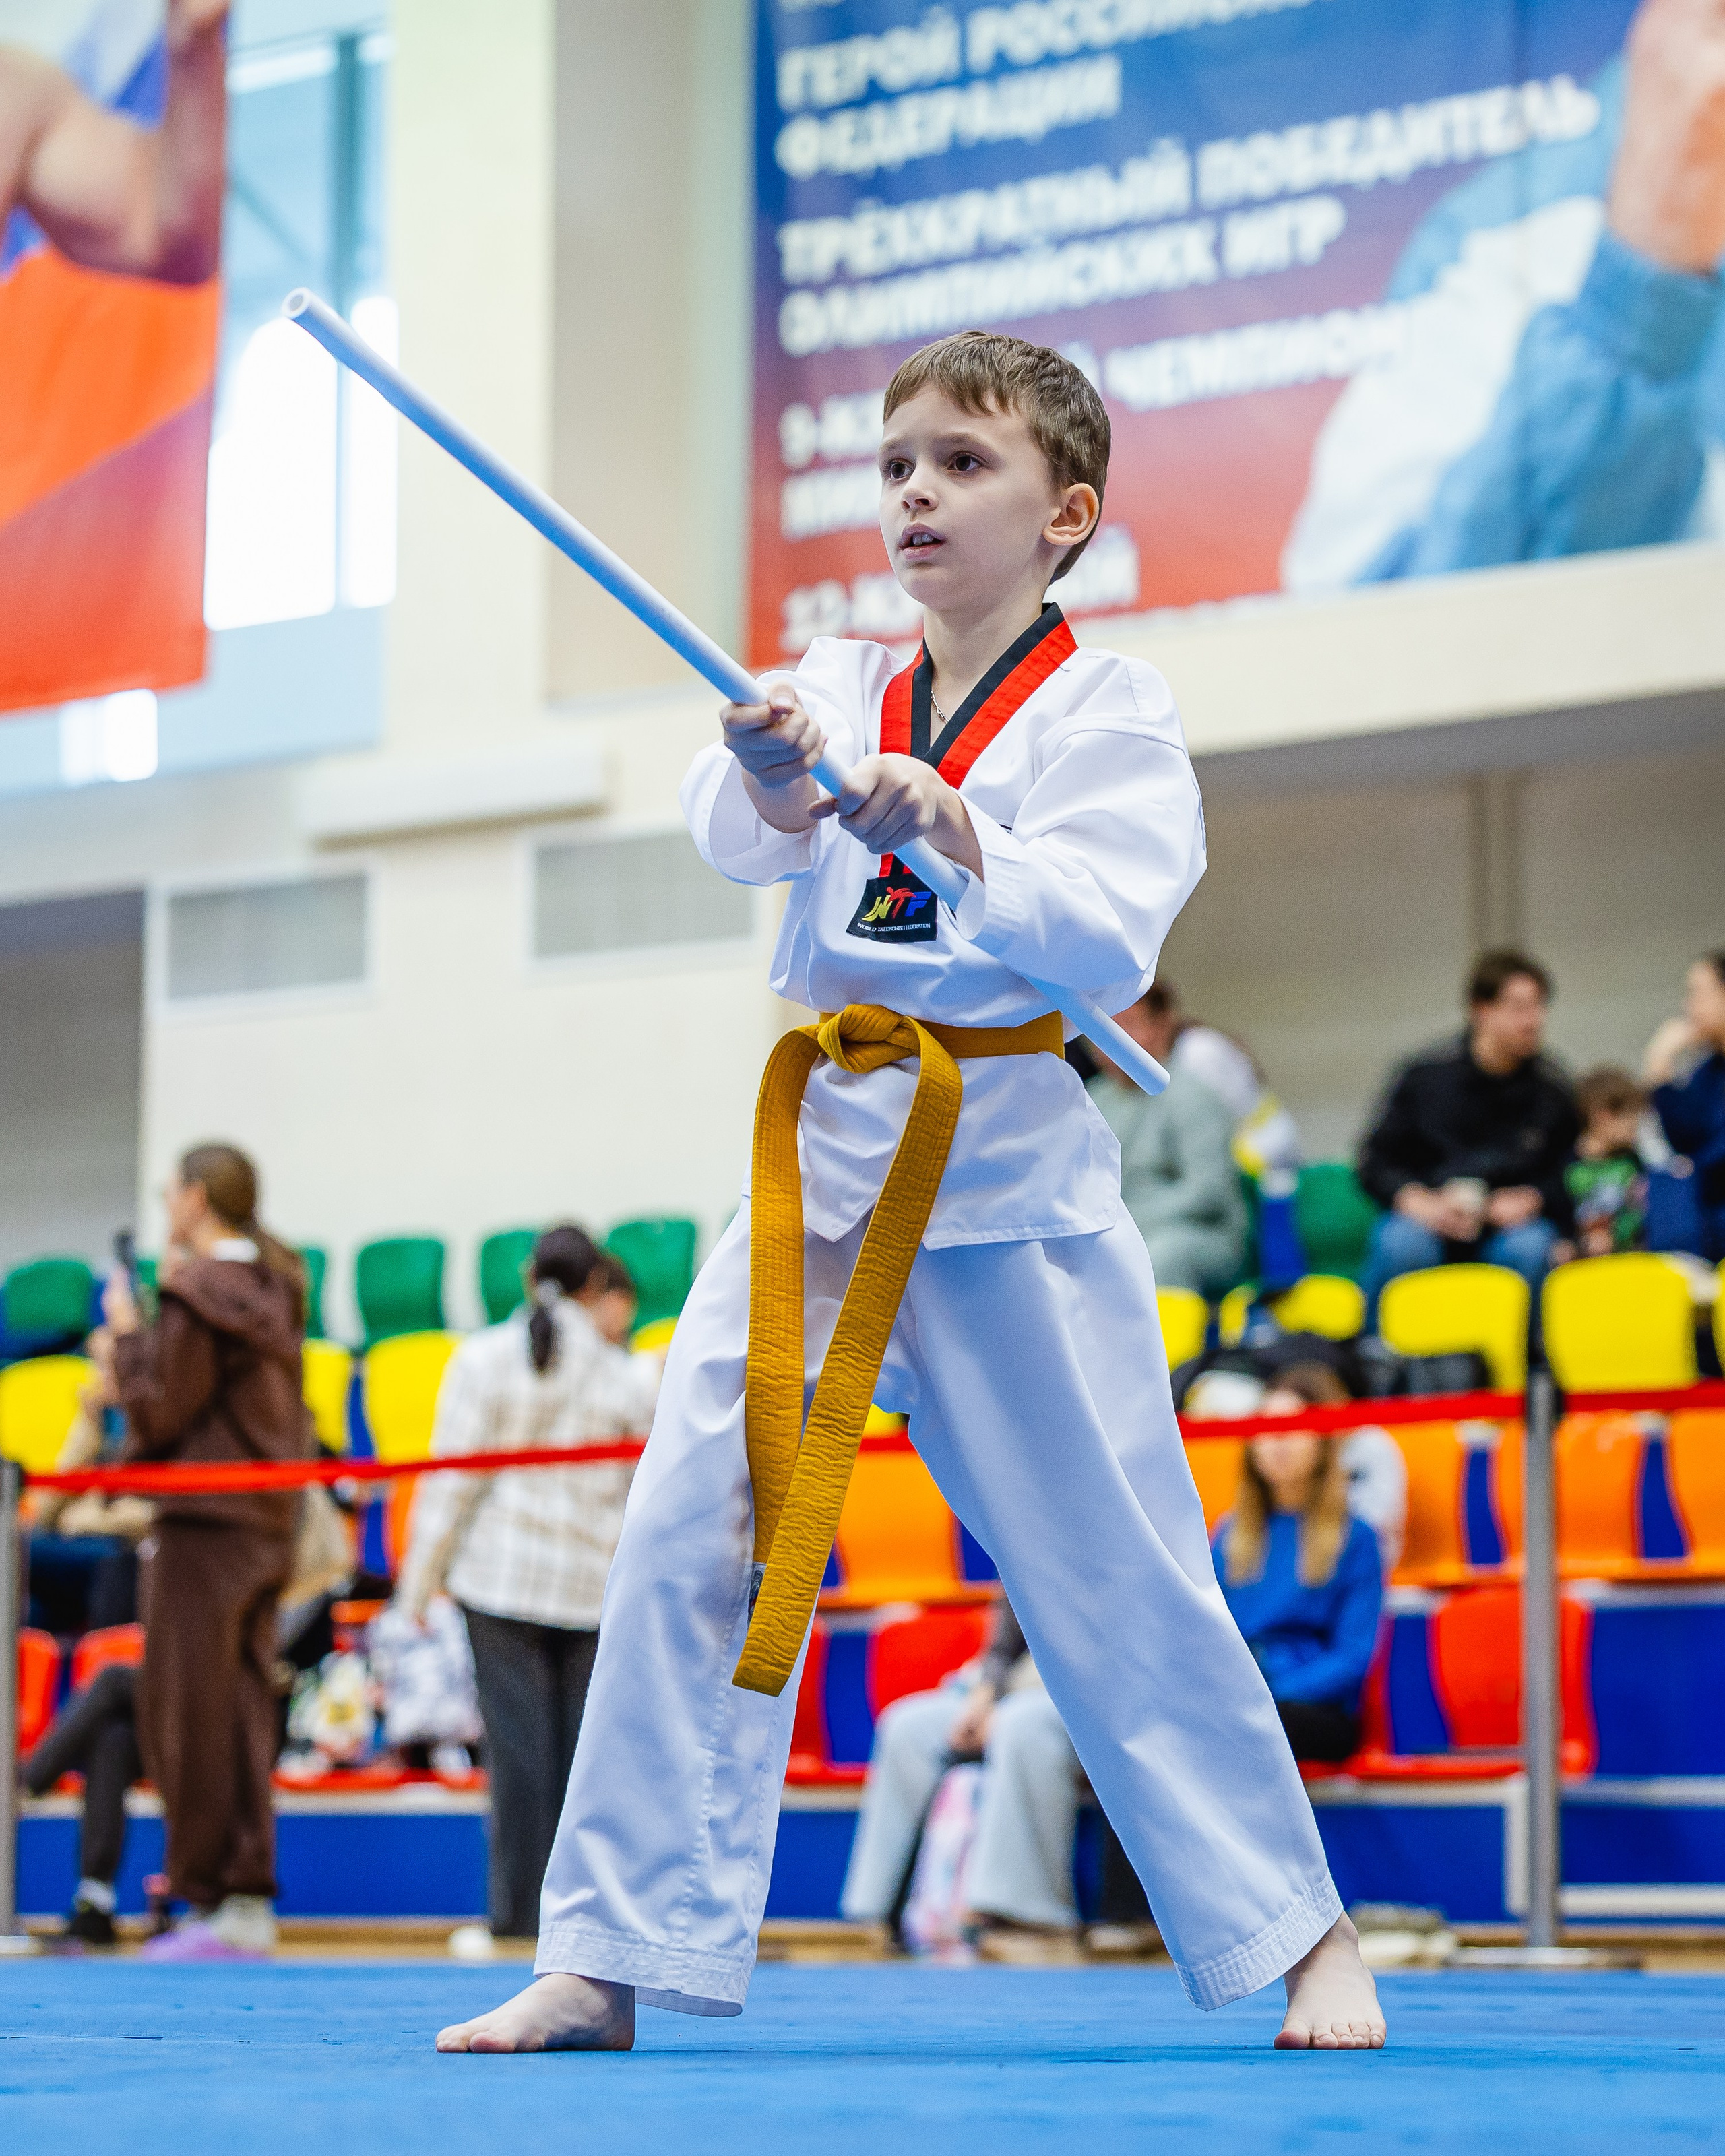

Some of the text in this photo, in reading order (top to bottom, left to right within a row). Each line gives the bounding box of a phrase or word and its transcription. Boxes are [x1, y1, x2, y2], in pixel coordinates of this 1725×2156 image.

[777, 7, 960, 113] ГЕРОЙ
[776, 54, 1121, 178] ФЕДЕРАЦИИ
[1195, 74, 1600, 210] ПОБЕДИТЕЛЬ
[1222, 195, 1344, 277] ИГР
[857, 922, 877, 932] WORLD
[861, 887, 932, 922] WTF
